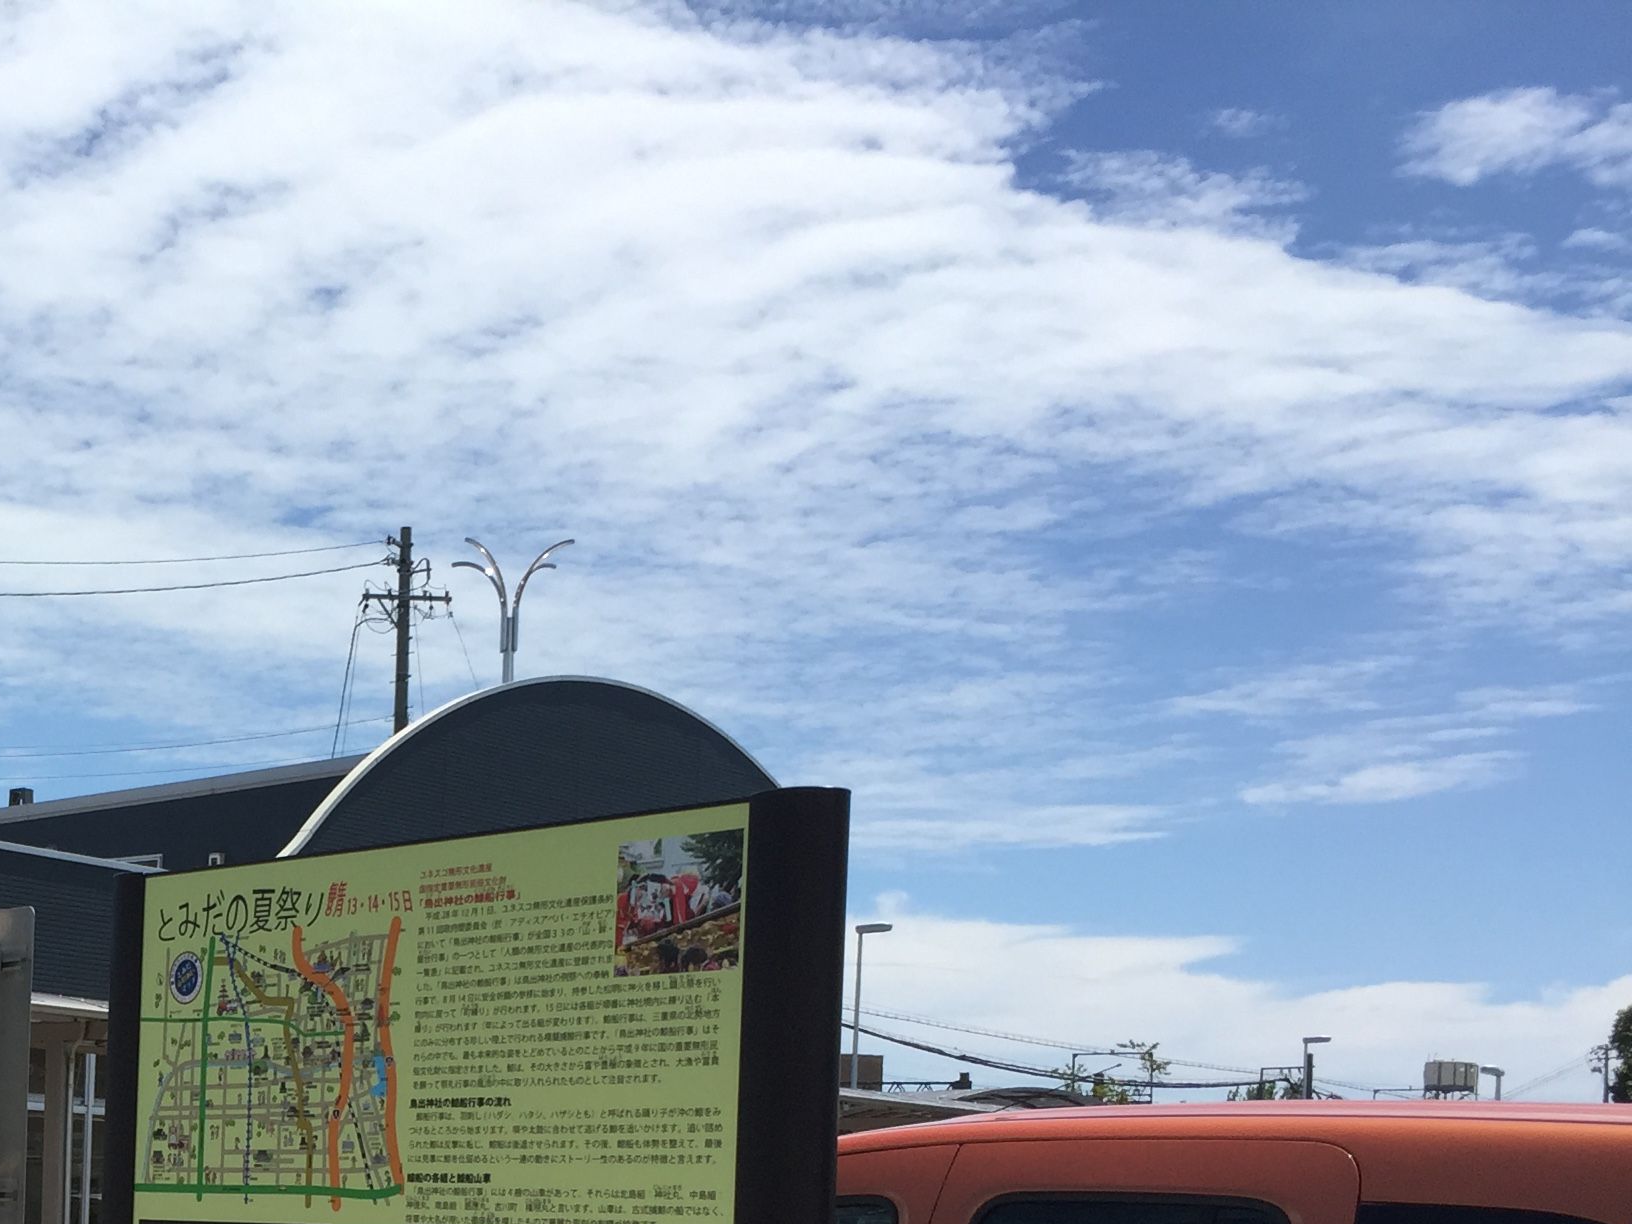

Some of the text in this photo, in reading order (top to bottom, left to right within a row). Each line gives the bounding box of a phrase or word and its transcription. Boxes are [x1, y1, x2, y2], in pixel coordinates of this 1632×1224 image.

[158, 886, 325, 942] とみだの夏祭り
